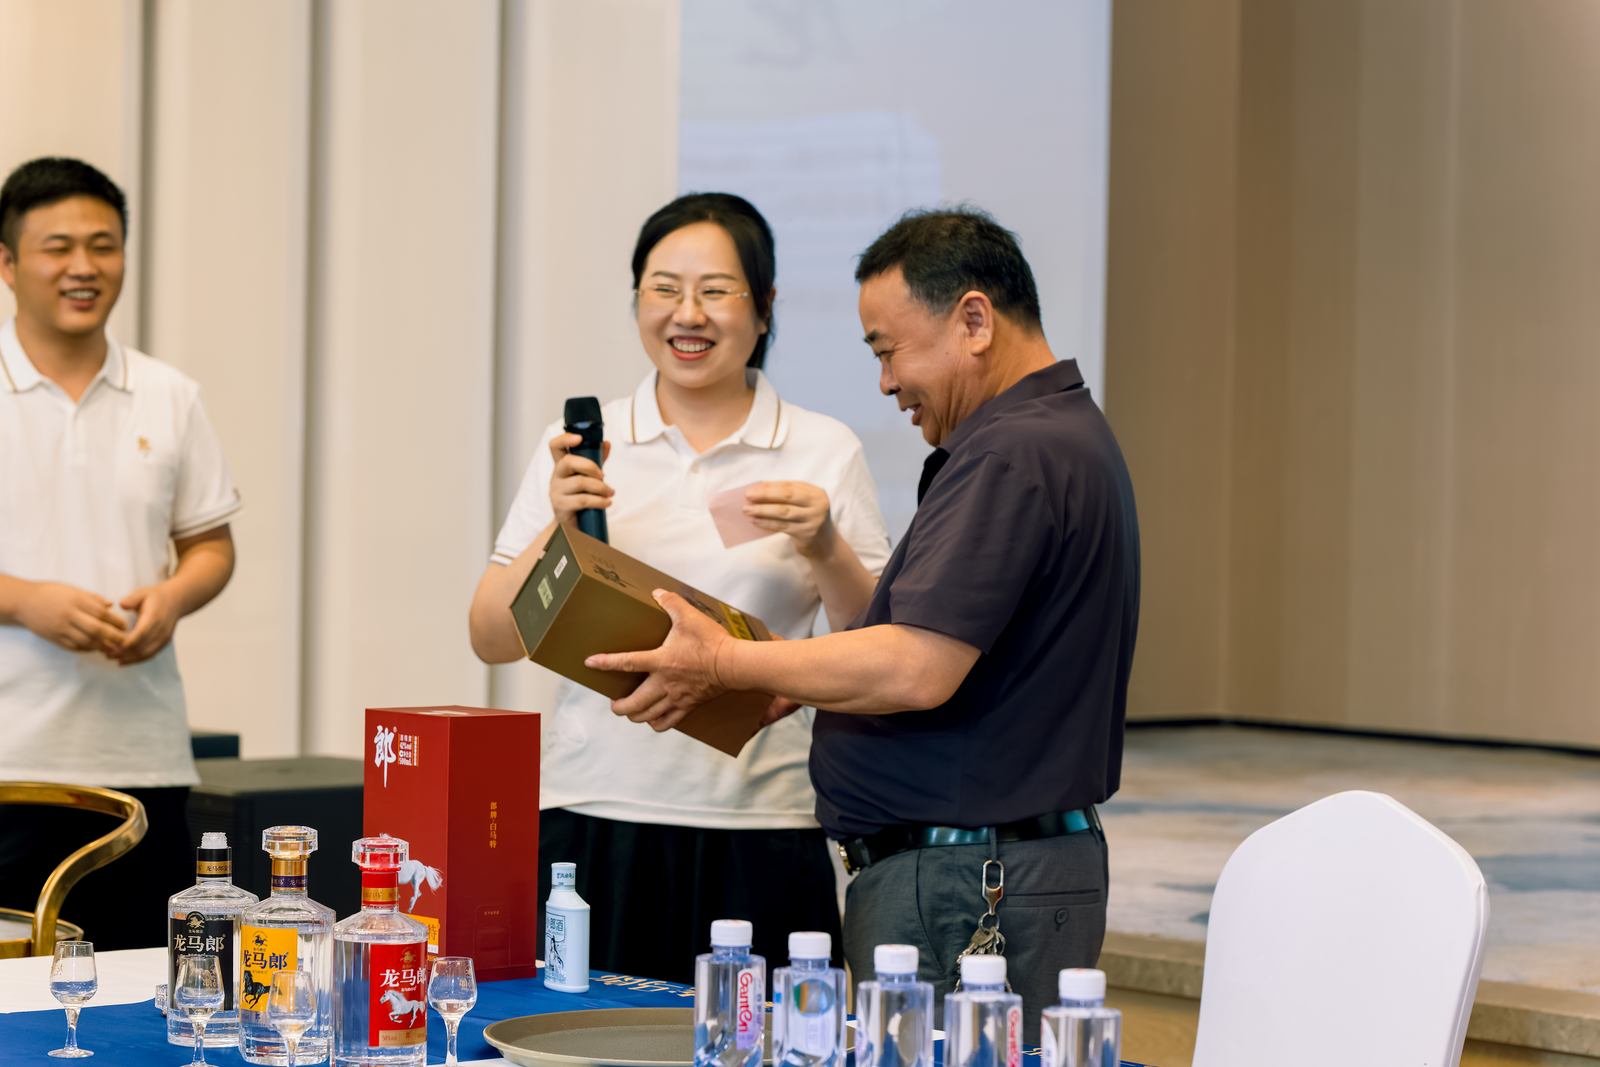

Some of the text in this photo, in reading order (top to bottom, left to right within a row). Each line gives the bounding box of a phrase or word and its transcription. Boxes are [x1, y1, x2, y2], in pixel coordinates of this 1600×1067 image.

[373, 724, 397, 789] 郎
[173, 933, 225, 953] 龙马郎
[242, 949, 289, 971] 龙马郎
[379, 967, 427, 988] 龙马郎
